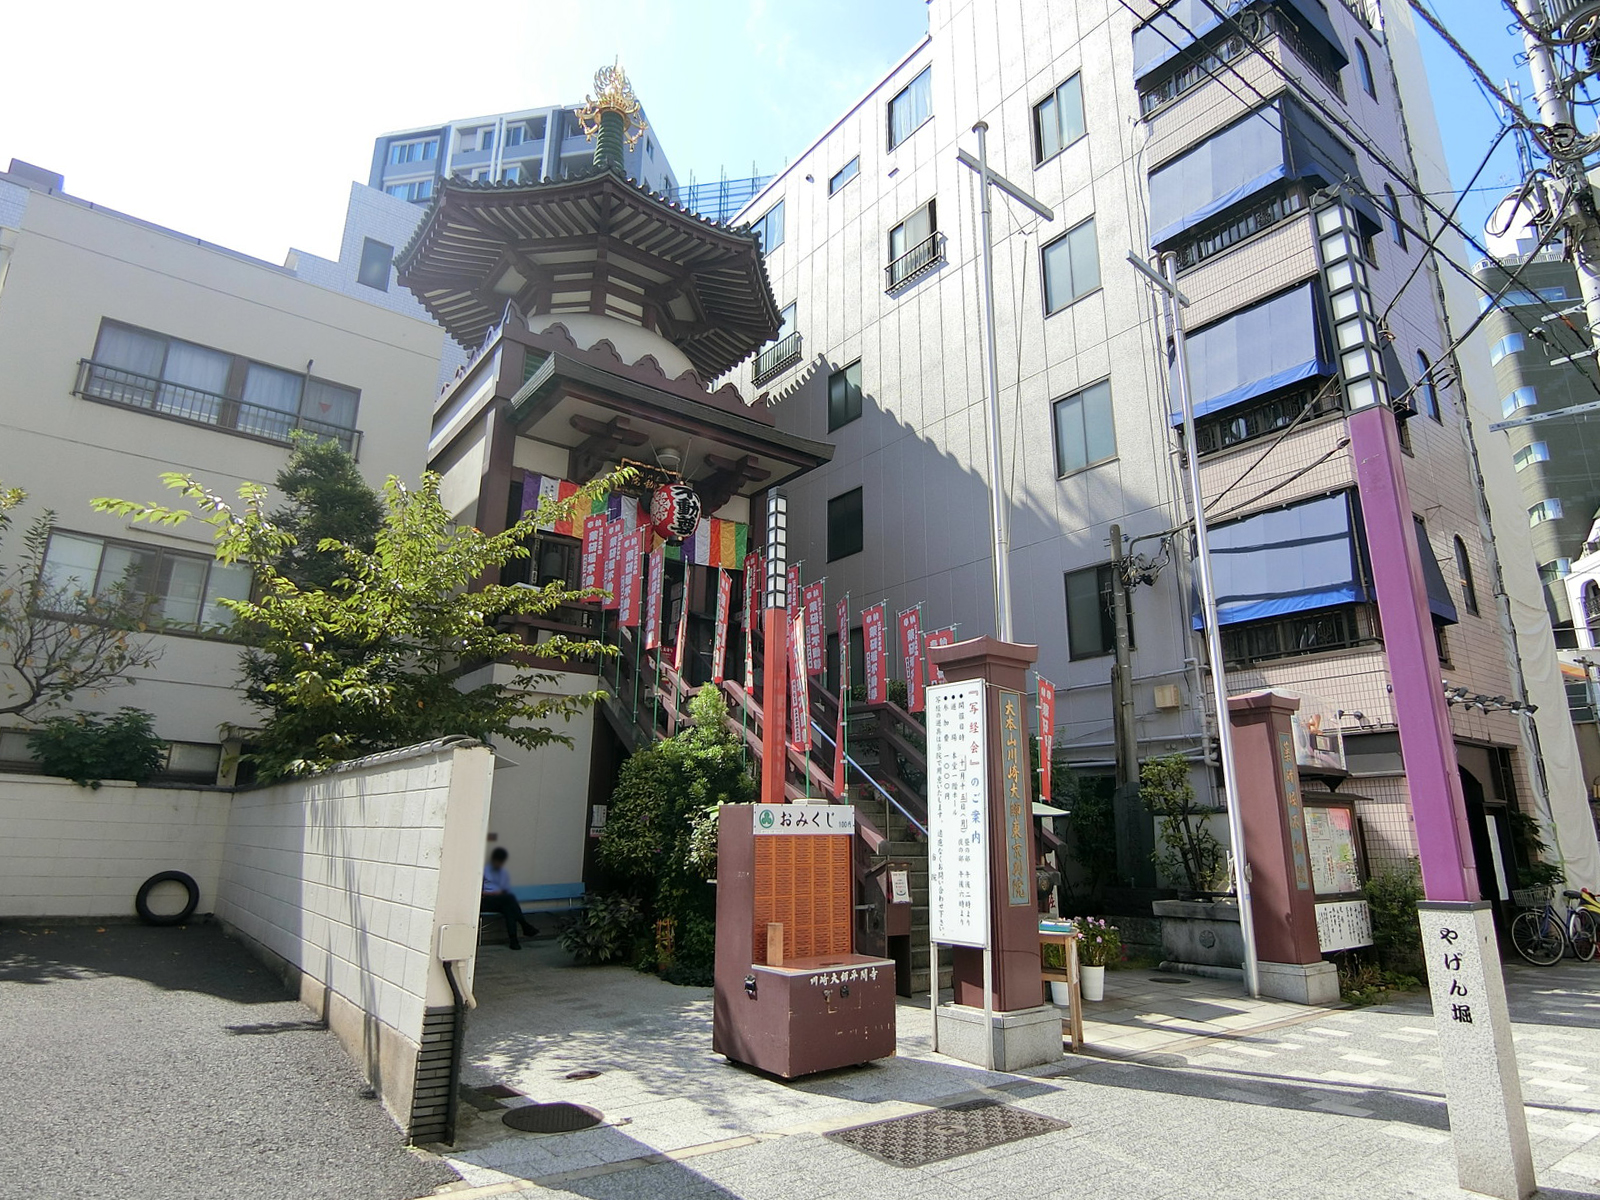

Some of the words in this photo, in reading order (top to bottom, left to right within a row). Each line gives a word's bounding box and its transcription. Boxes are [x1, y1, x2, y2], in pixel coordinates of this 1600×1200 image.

[668, 485, 700, 536] 不動尊
[968, 690, 981, 844] 『写経会』のご案内
[1004, 699, 1025, 899] 大本山川崎大師東京別院
[780, 811, 835, 828] おみくじ
[1439, 927, 1473, 1024] やげん堀
